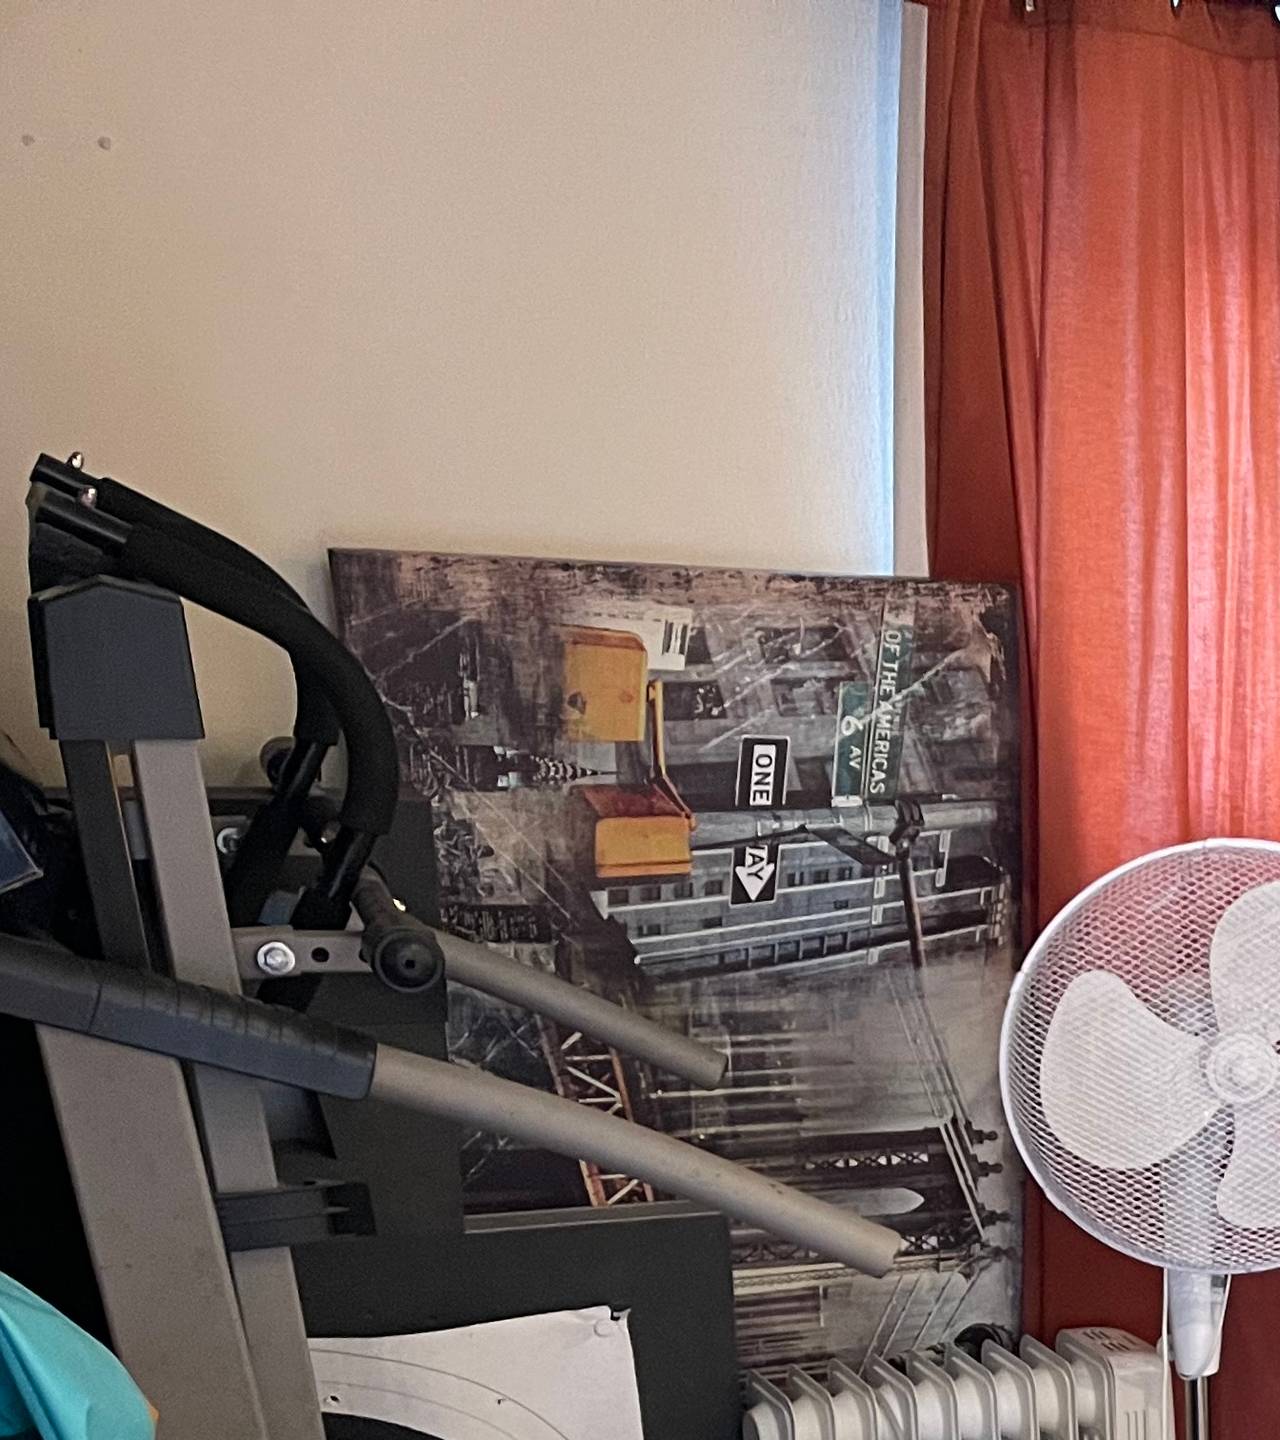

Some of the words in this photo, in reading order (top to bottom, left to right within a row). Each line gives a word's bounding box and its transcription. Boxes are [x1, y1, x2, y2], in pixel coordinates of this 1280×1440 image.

[884, 630, 901, 658] OF
[879, 659, 899, 698] THE
[841, 715, 864, 736] 6
[849, 745, 862, 770] AV
[869, 699, 894, 796] AMERICAS
[753, 753, 772, 802] ONE
